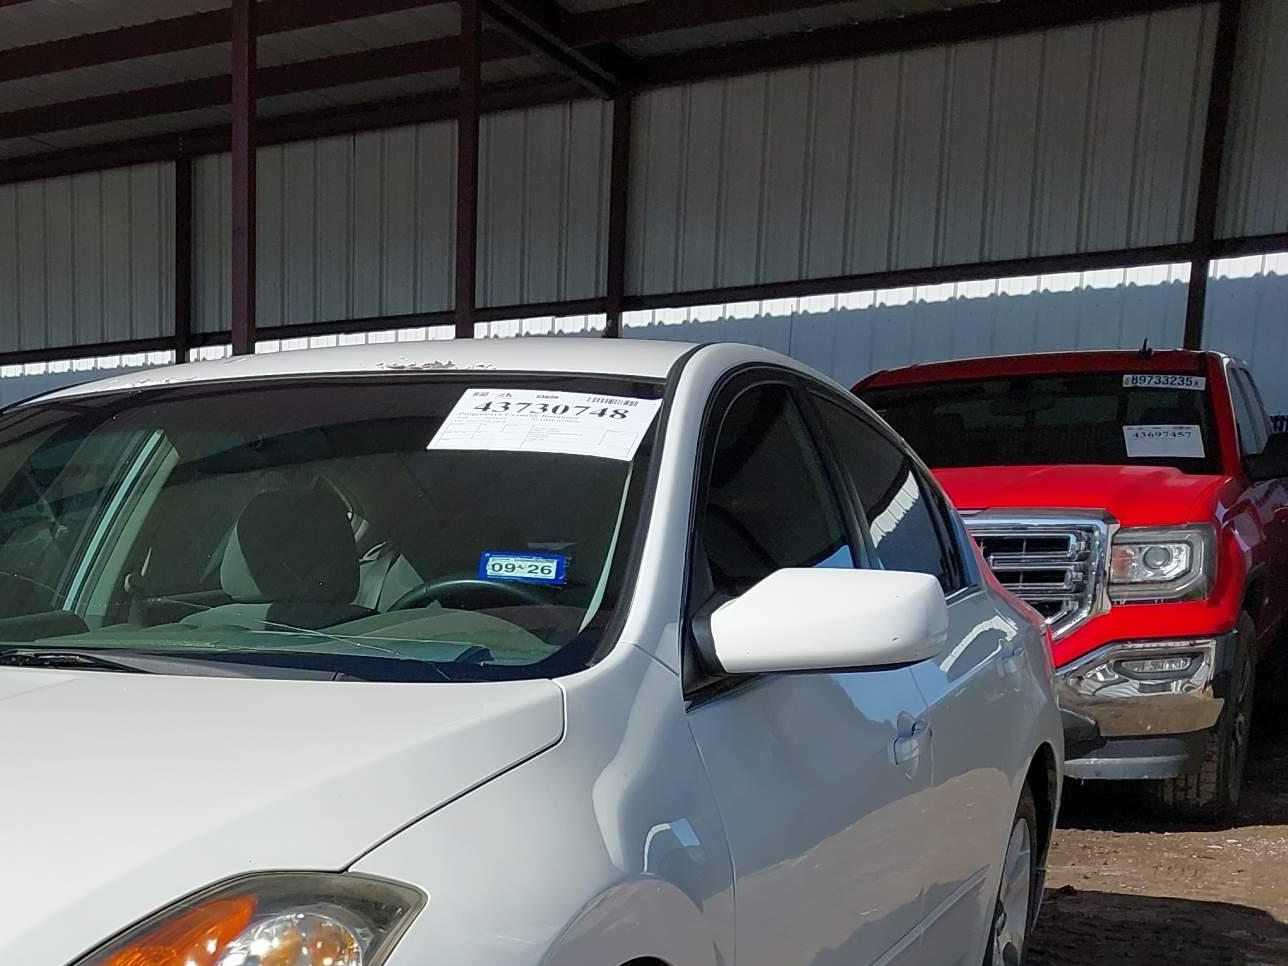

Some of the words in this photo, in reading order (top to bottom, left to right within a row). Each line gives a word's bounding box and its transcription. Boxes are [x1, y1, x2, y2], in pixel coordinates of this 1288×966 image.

[473, 400, 630, 420] 43730748
[491, 562, 516, 574] 09
[527, 564, 552, 575] 26
